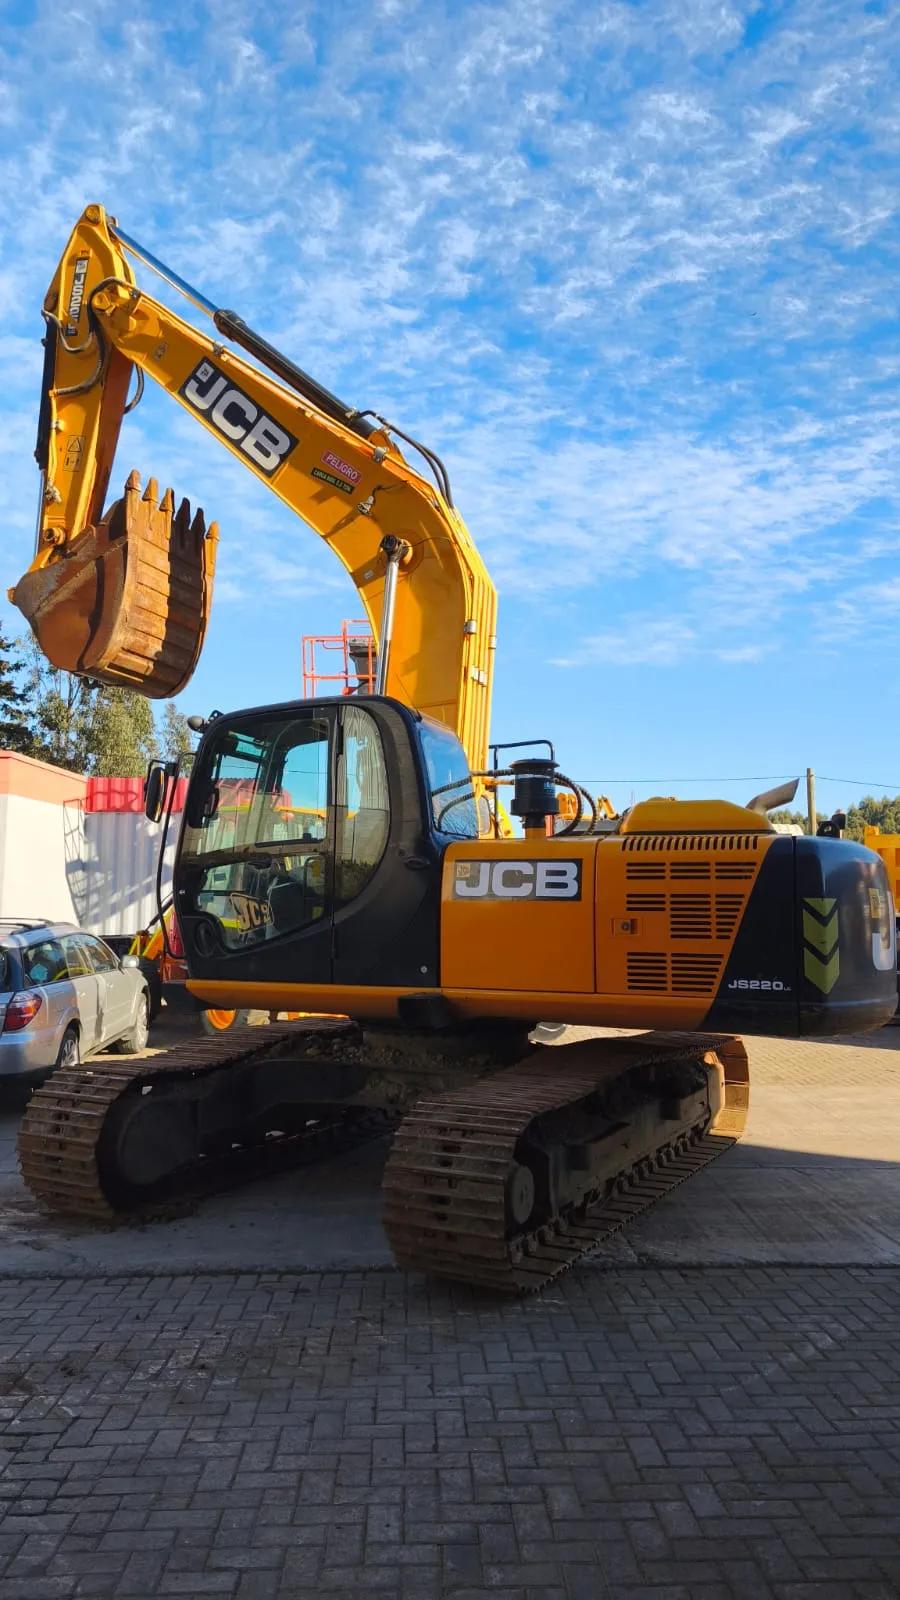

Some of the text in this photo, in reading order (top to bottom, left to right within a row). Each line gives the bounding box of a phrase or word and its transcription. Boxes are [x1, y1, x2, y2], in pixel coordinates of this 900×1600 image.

[184, 375, 291, 471] JCB
[326, 453, 358, 480] PELIGRO
[455, 861, 579, 897] JCB
